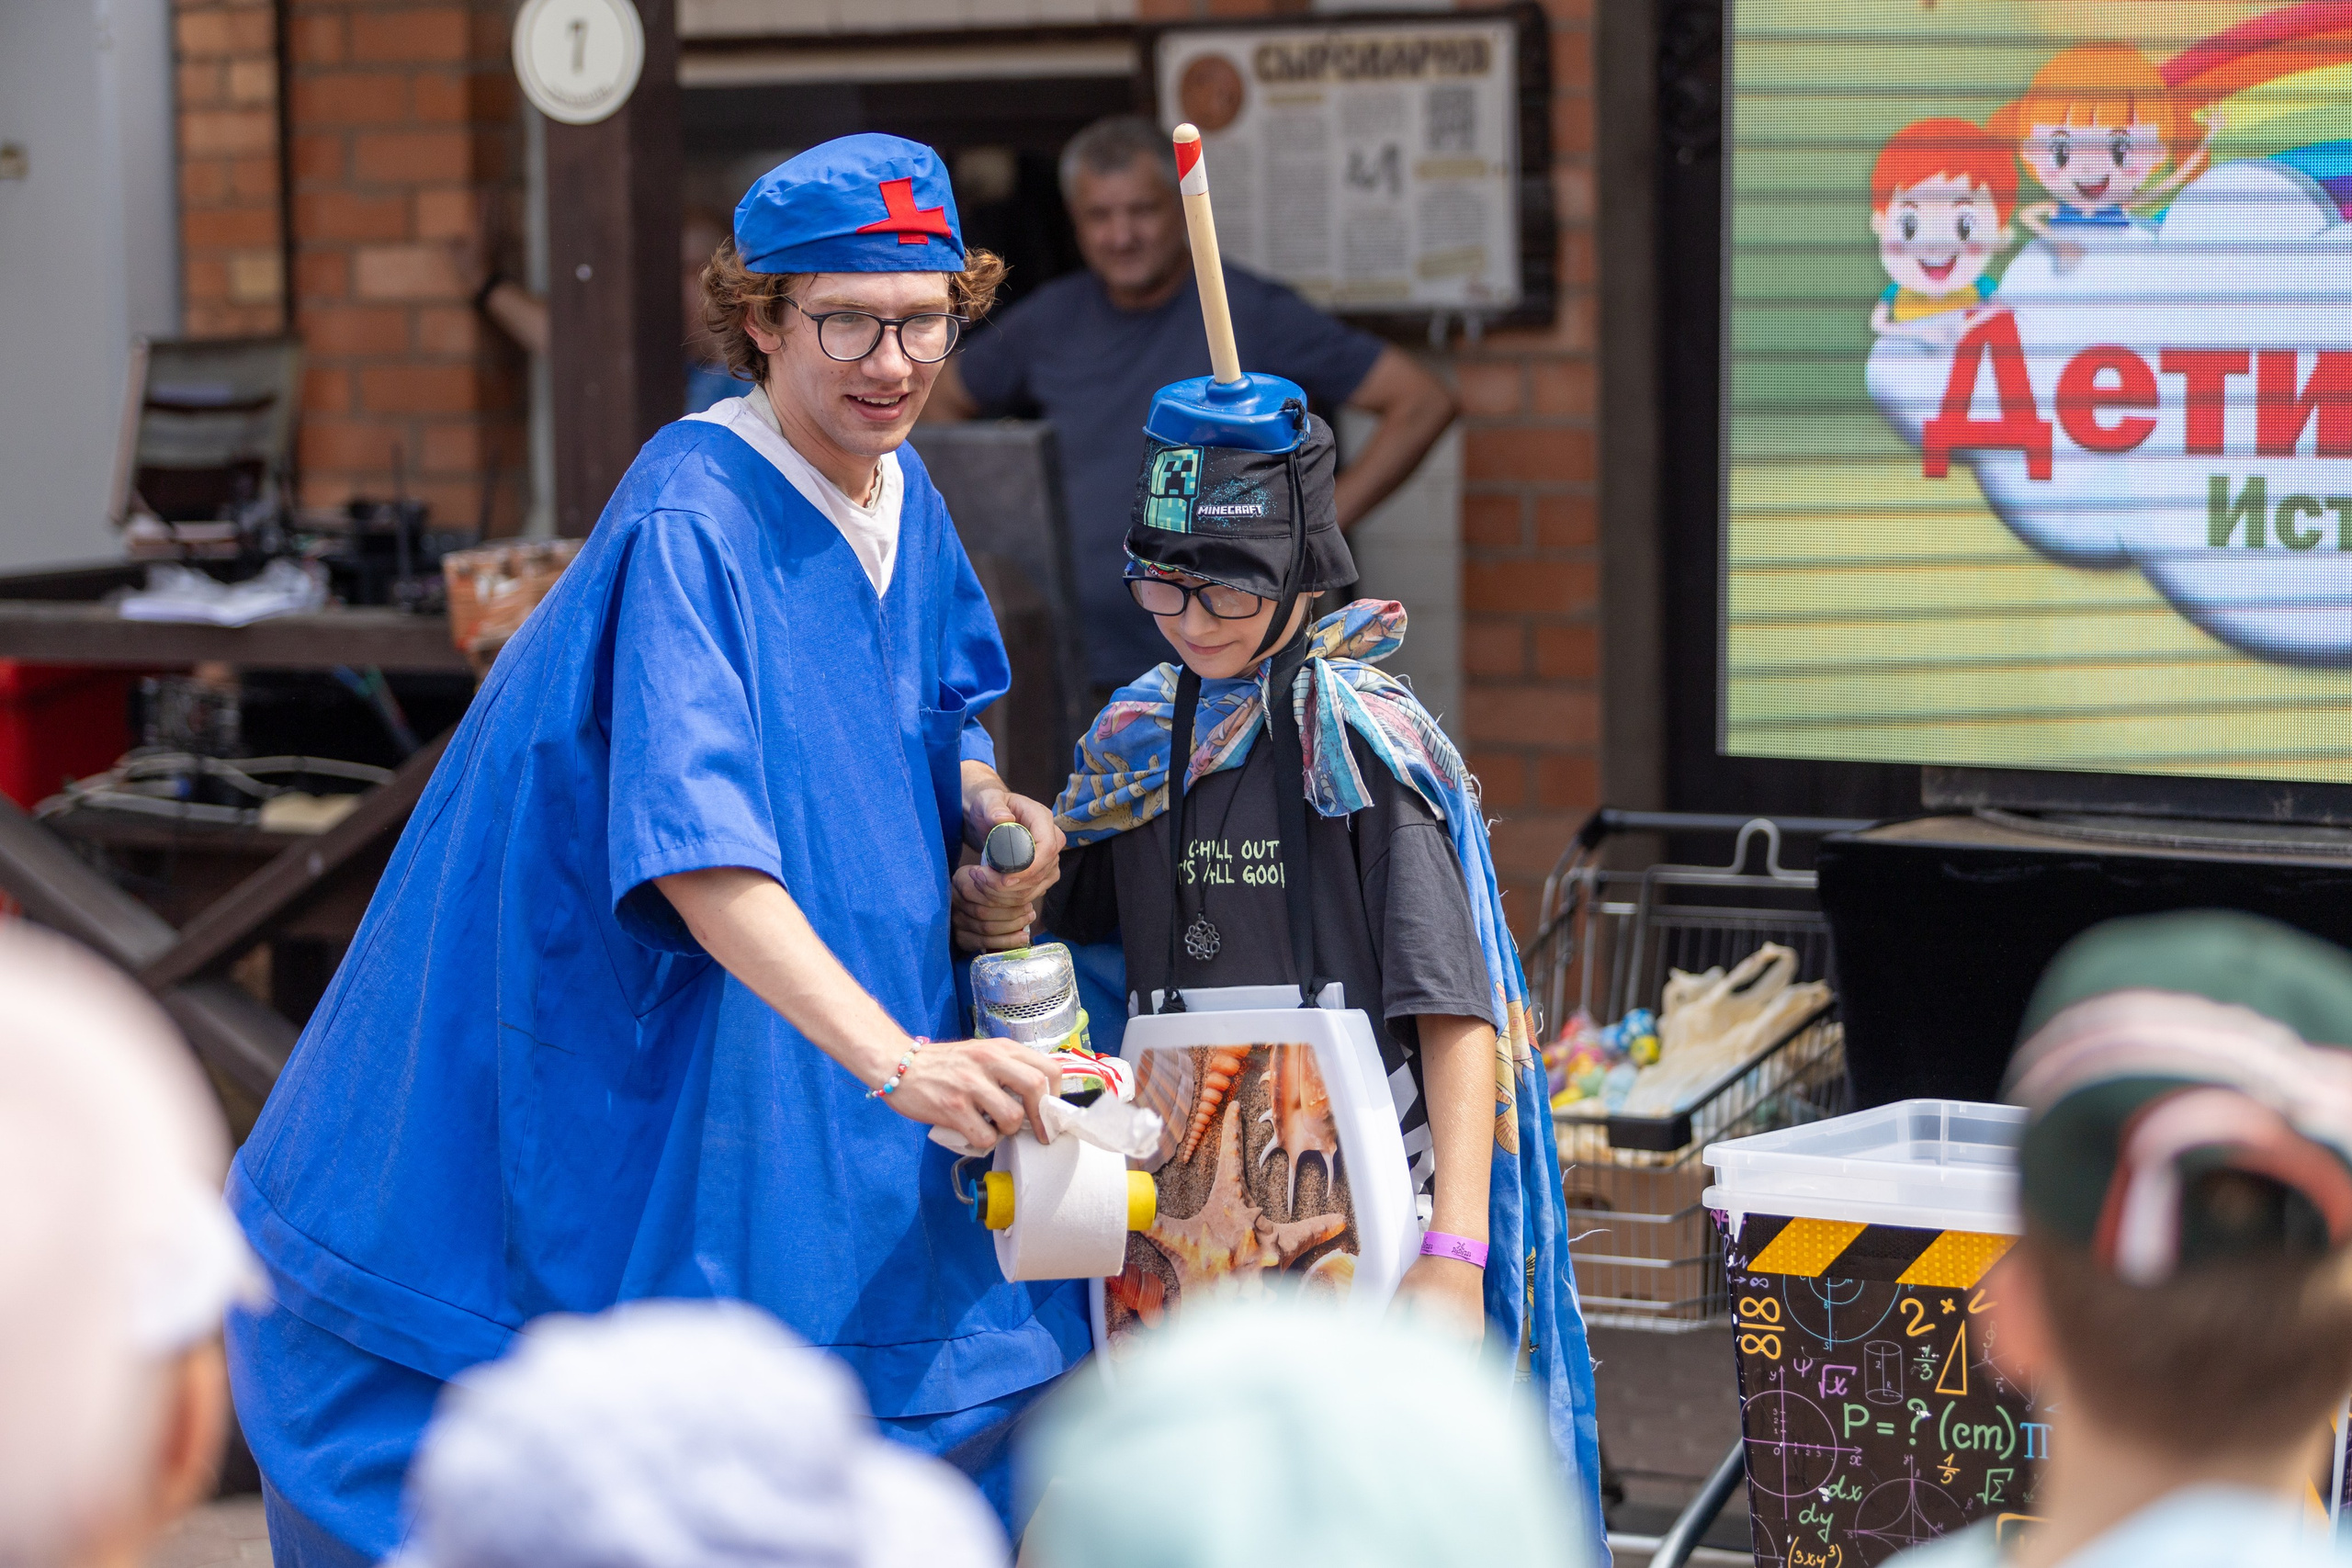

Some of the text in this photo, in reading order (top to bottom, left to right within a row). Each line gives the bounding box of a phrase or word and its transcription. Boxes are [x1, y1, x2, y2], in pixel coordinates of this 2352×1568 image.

[1923, 309, 2352, 481] Дети
[1196, 504, 1262, 517] MINECRAFT
[1188, 839, 1280, 863] CHILL OUT
[1177, 860, 1196, 886] T'S
[1203, 863, 1235, 886] ALL
[1827, 1474, 1862, 1501] dx
[1798, 1502, 1834, 1543] dy
